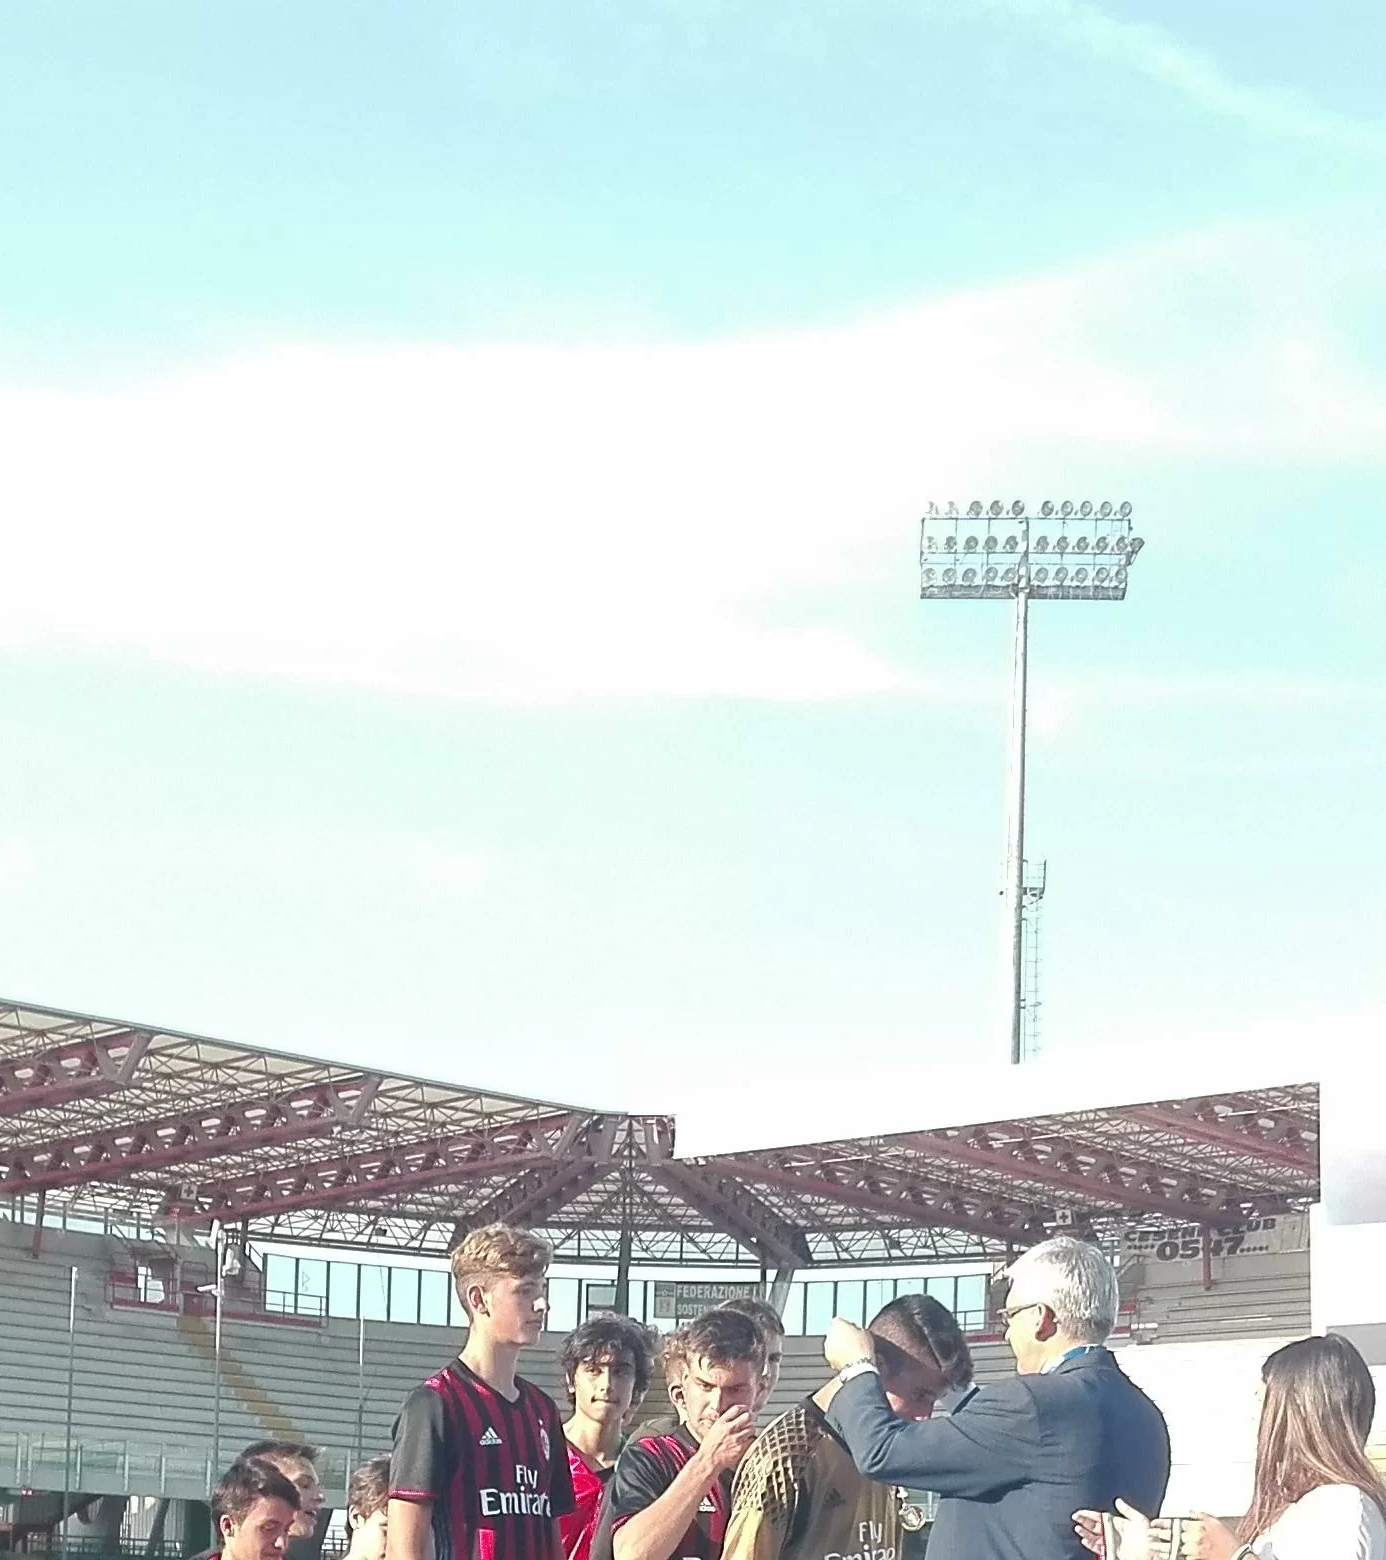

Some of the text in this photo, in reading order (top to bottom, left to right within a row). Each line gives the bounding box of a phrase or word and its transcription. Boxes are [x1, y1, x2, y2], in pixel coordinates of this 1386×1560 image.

[676, 1285, 751, 1300] FEDERAZIONE
[515, 1464, 538, 1489] Fly
[859, 1520, 883, 1543] Fly
